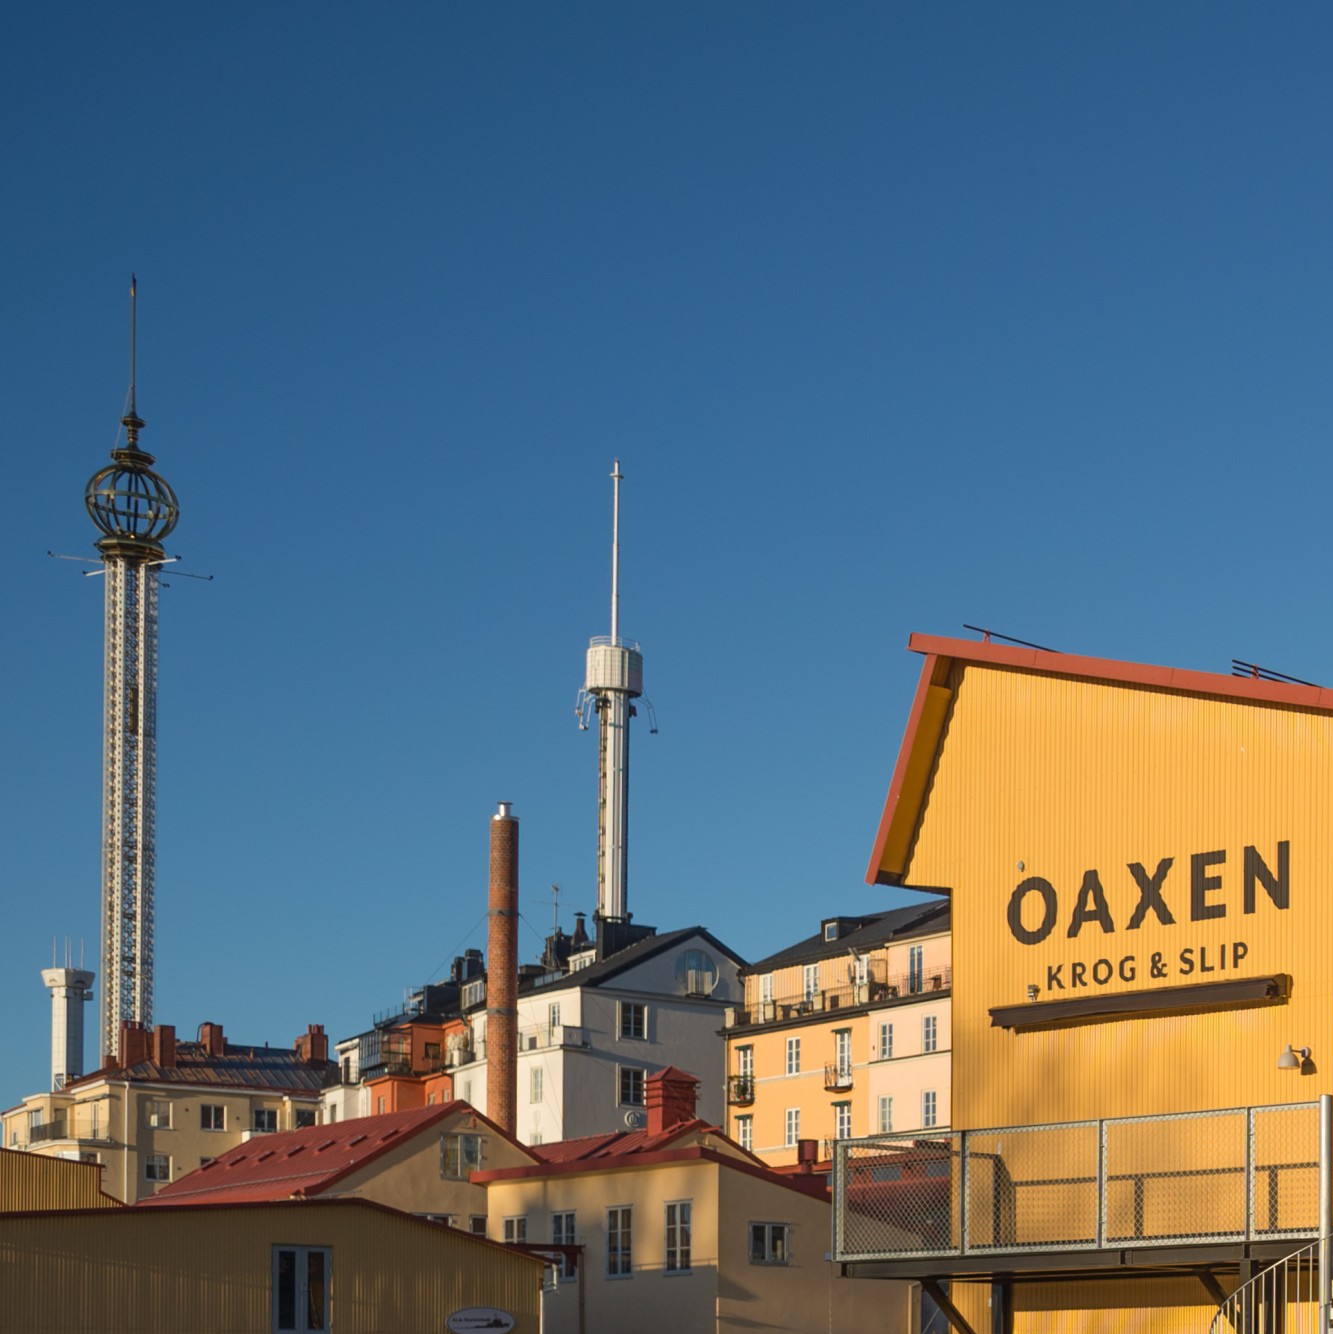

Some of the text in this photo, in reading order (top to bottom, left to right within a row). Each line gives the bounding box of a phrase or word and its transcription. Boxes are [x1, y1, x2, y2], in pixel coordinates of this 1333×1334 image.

[1007, 840, 1290, 945] OAXEN
[1047, 941, 1249, 991] KROG & SLIP
